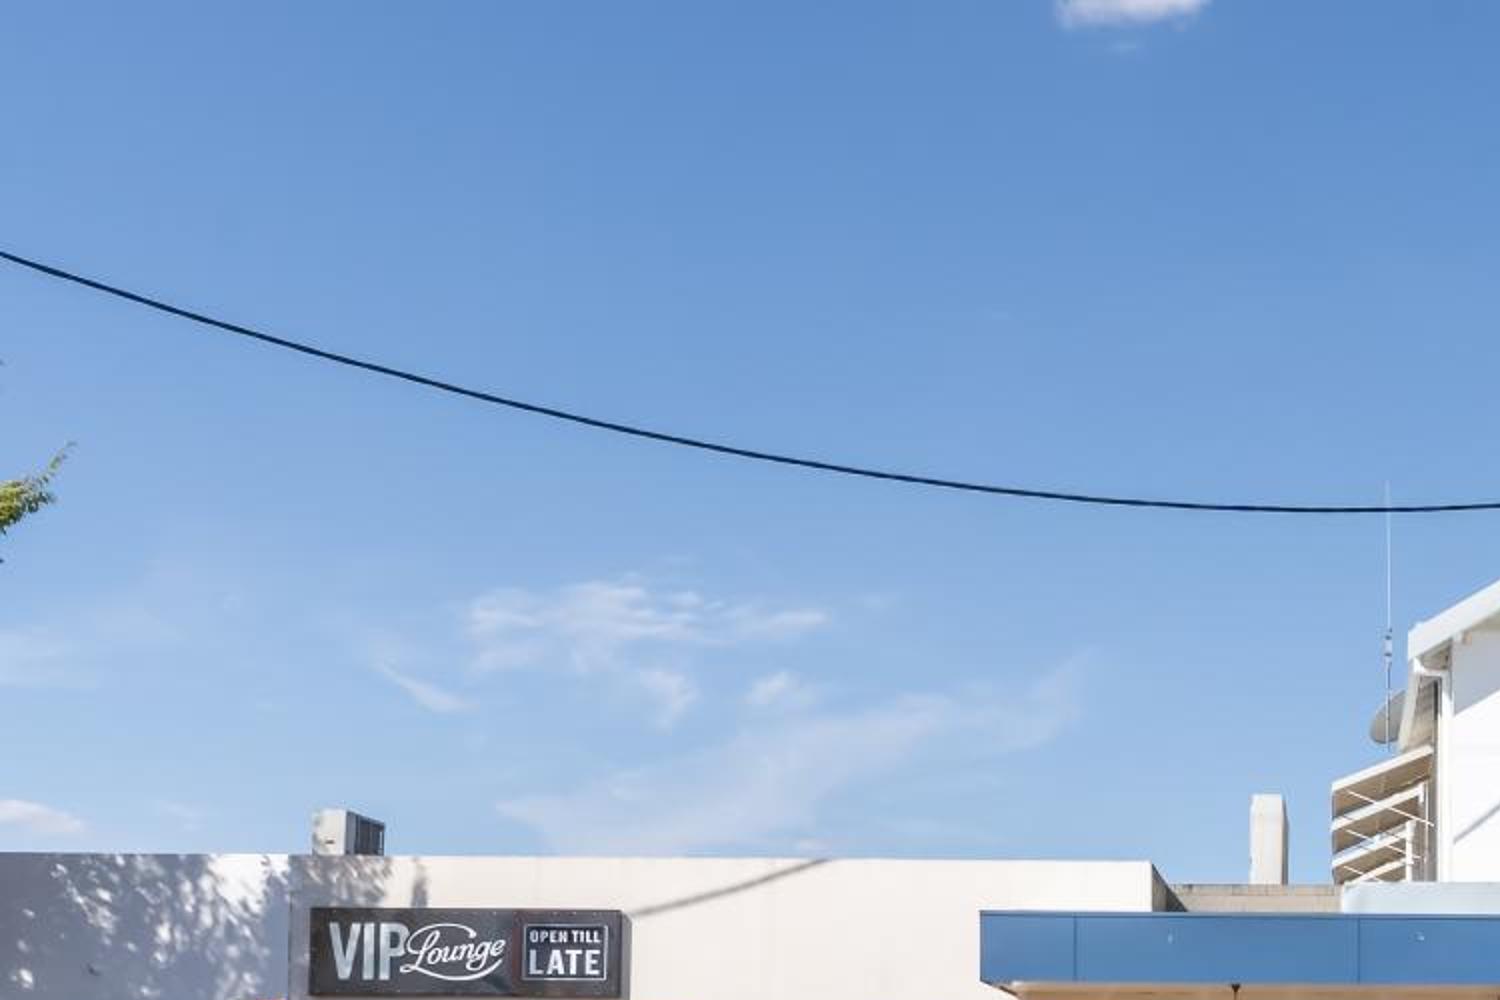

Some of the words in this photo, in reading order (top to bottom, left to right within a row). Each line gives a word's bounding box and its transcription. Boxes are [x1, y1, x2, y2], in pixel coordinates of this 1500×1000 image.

[529, 929, 568, 943] OPEN
[571, 930, 602, 943] TILL
[329, 921, 411, 981] VIP
[400, 922, 507, 981] Lounge
[528, 949, 601, 976] LATE
